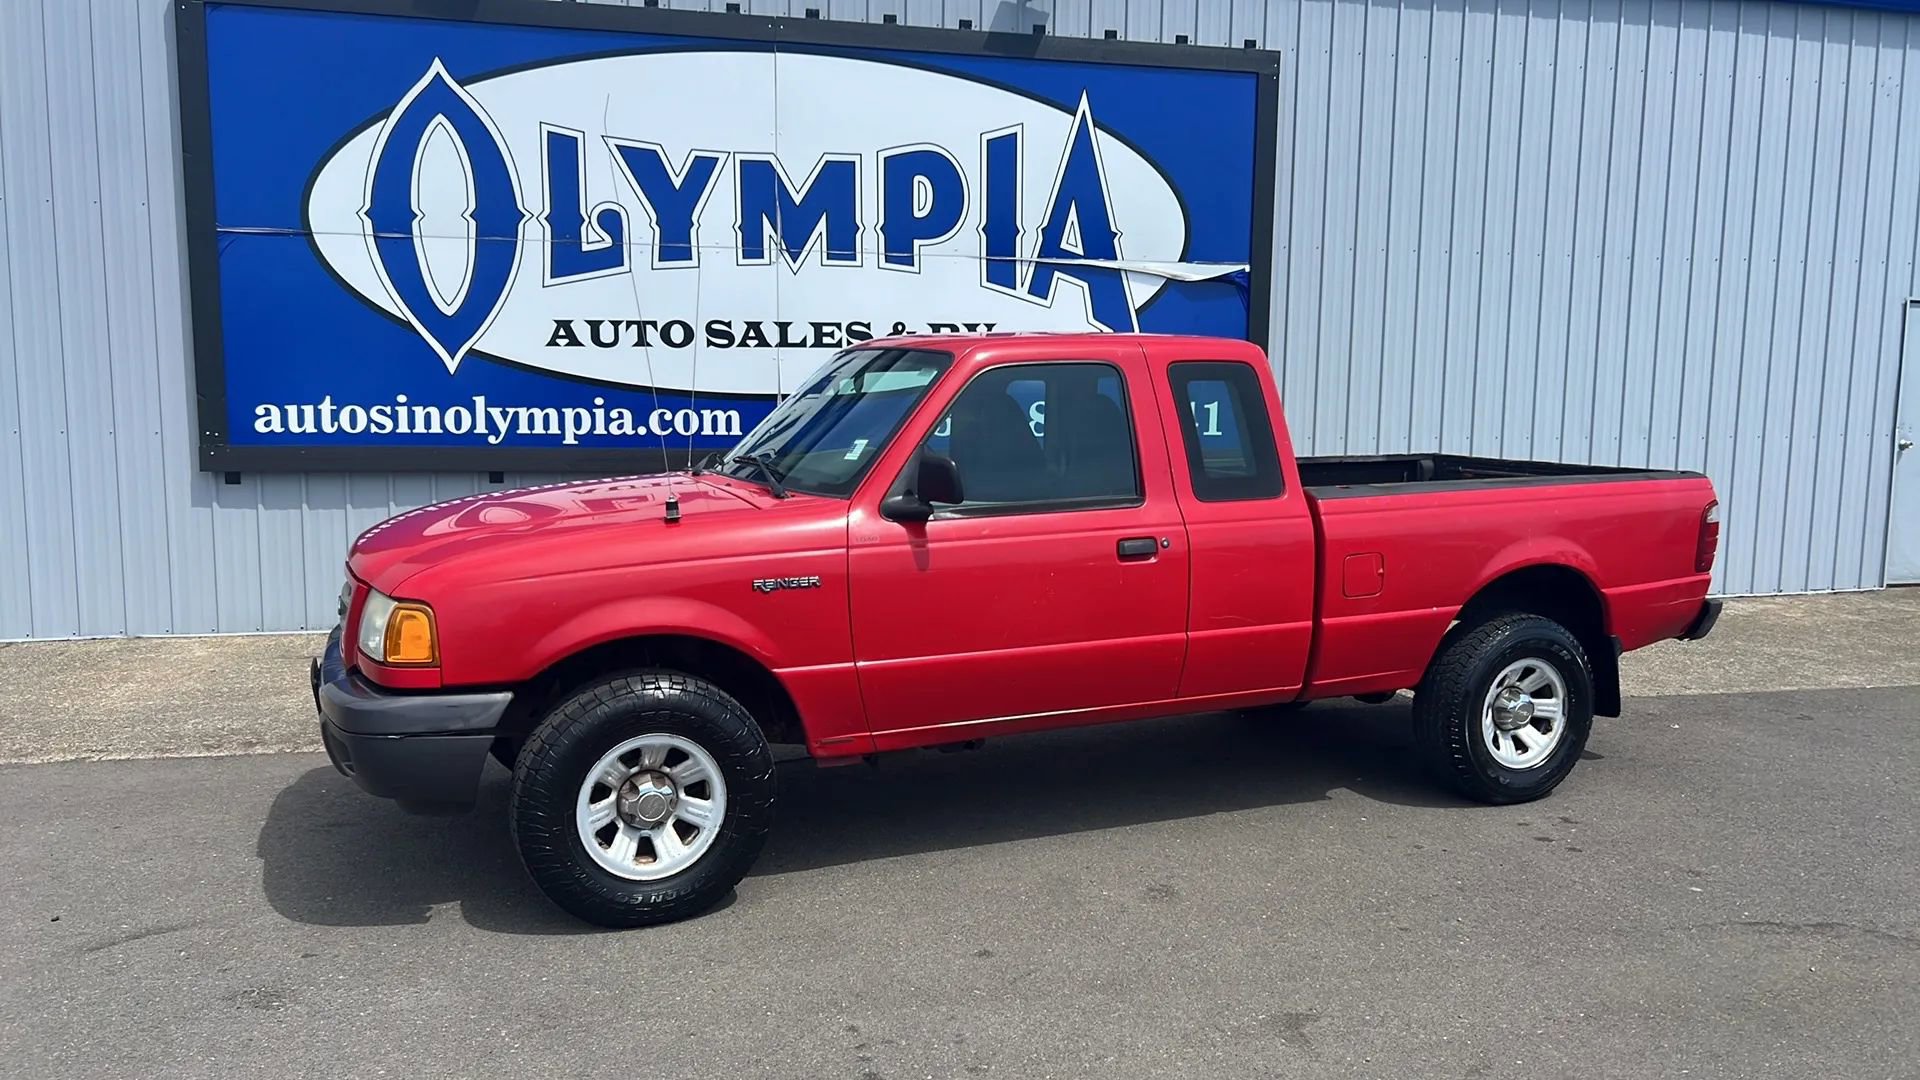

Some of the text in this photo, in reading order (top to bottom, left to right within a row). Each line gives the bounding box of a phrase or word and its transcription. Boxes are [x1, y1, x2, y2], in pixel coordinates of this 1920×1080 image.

[357, 57, 1143, 375] OLYMPIA
[545, 319, 695, 348] AUTO
[704, 319, 873, 348] SALES
[253, 393, 743, 445] autosinolympia.com
[752, 575, 821, 593] RANGER
